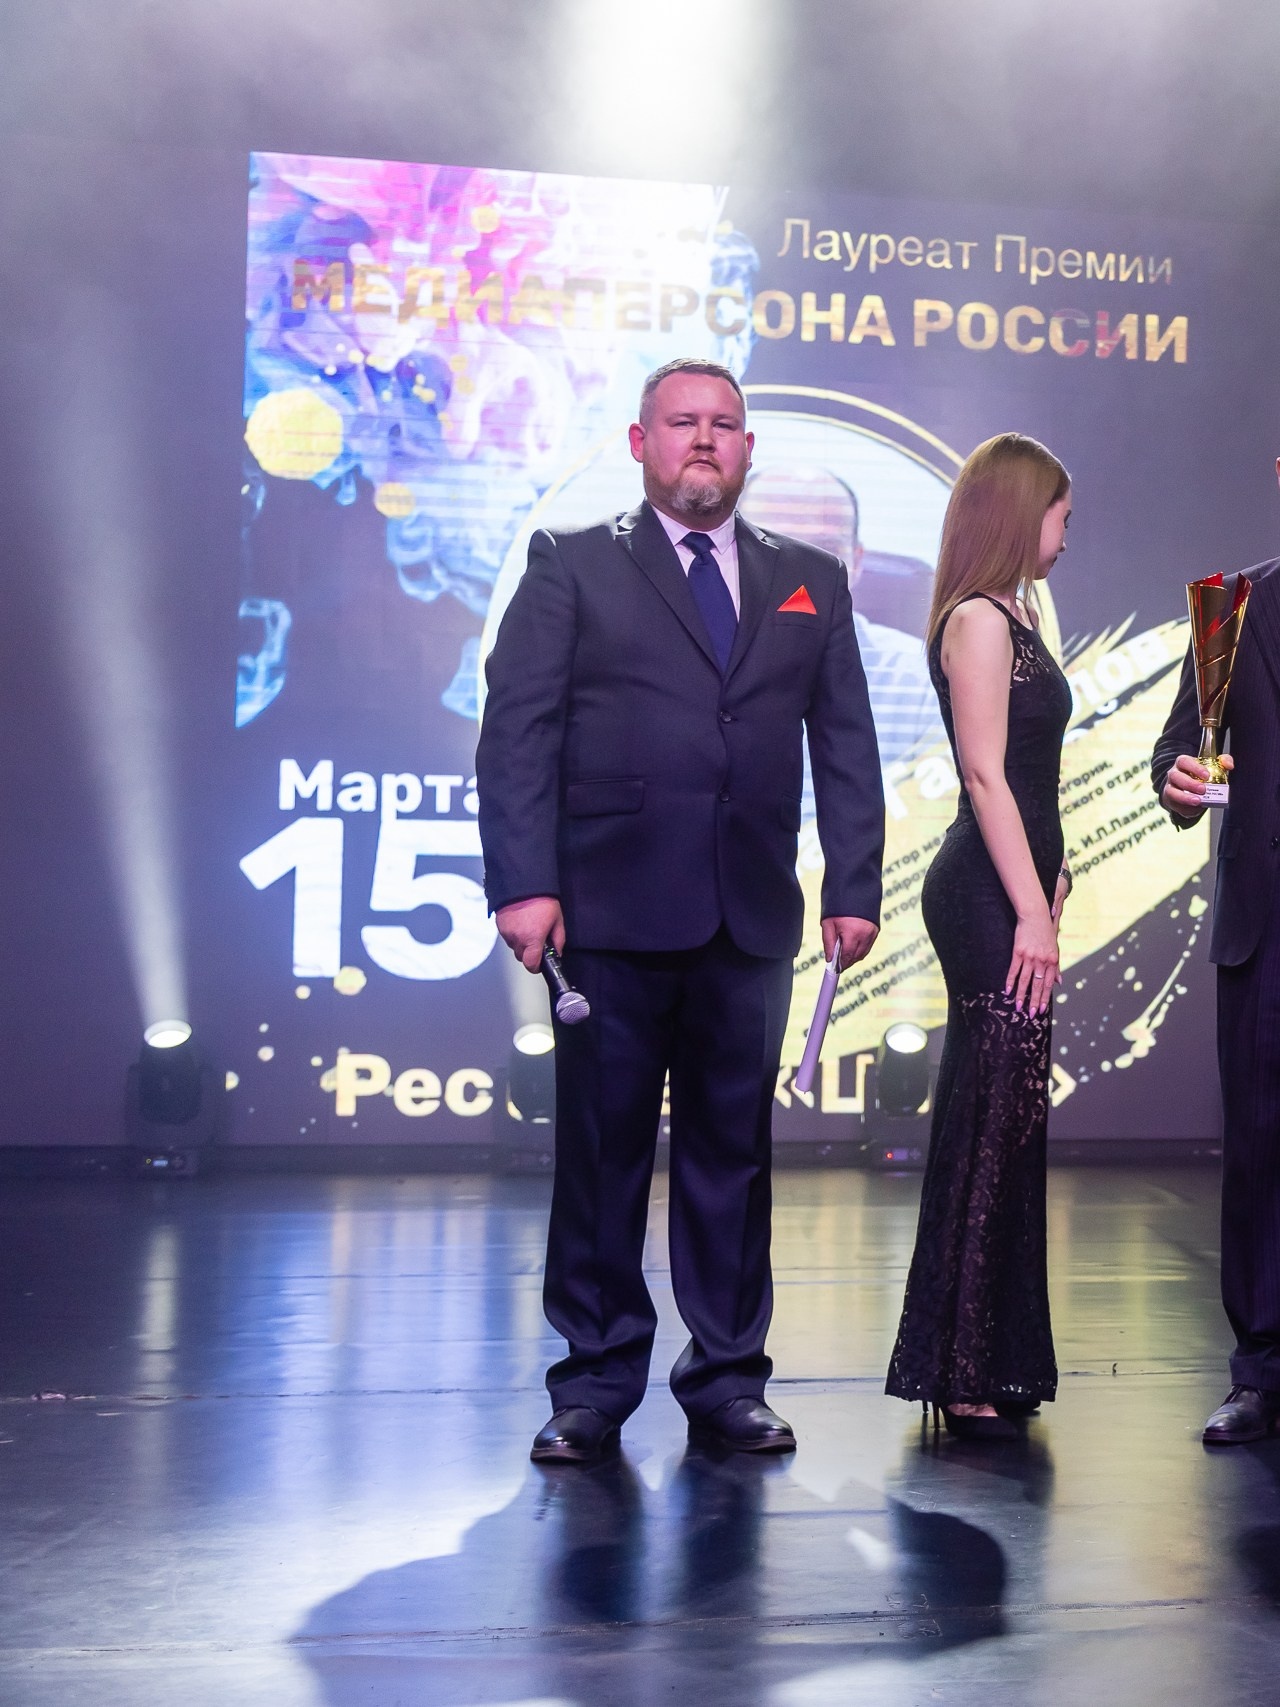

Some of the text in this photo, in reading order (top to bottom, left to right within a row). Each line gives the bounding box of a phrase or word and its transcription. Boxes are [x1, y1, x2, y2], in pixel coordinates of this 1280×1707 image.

[777, 218, 1172, 285] Лауреат Премии
[291, 258, 1188, 363] МЕДИАПЕРСОНА РОССИИ
[239, 817, 500, 981] 15
